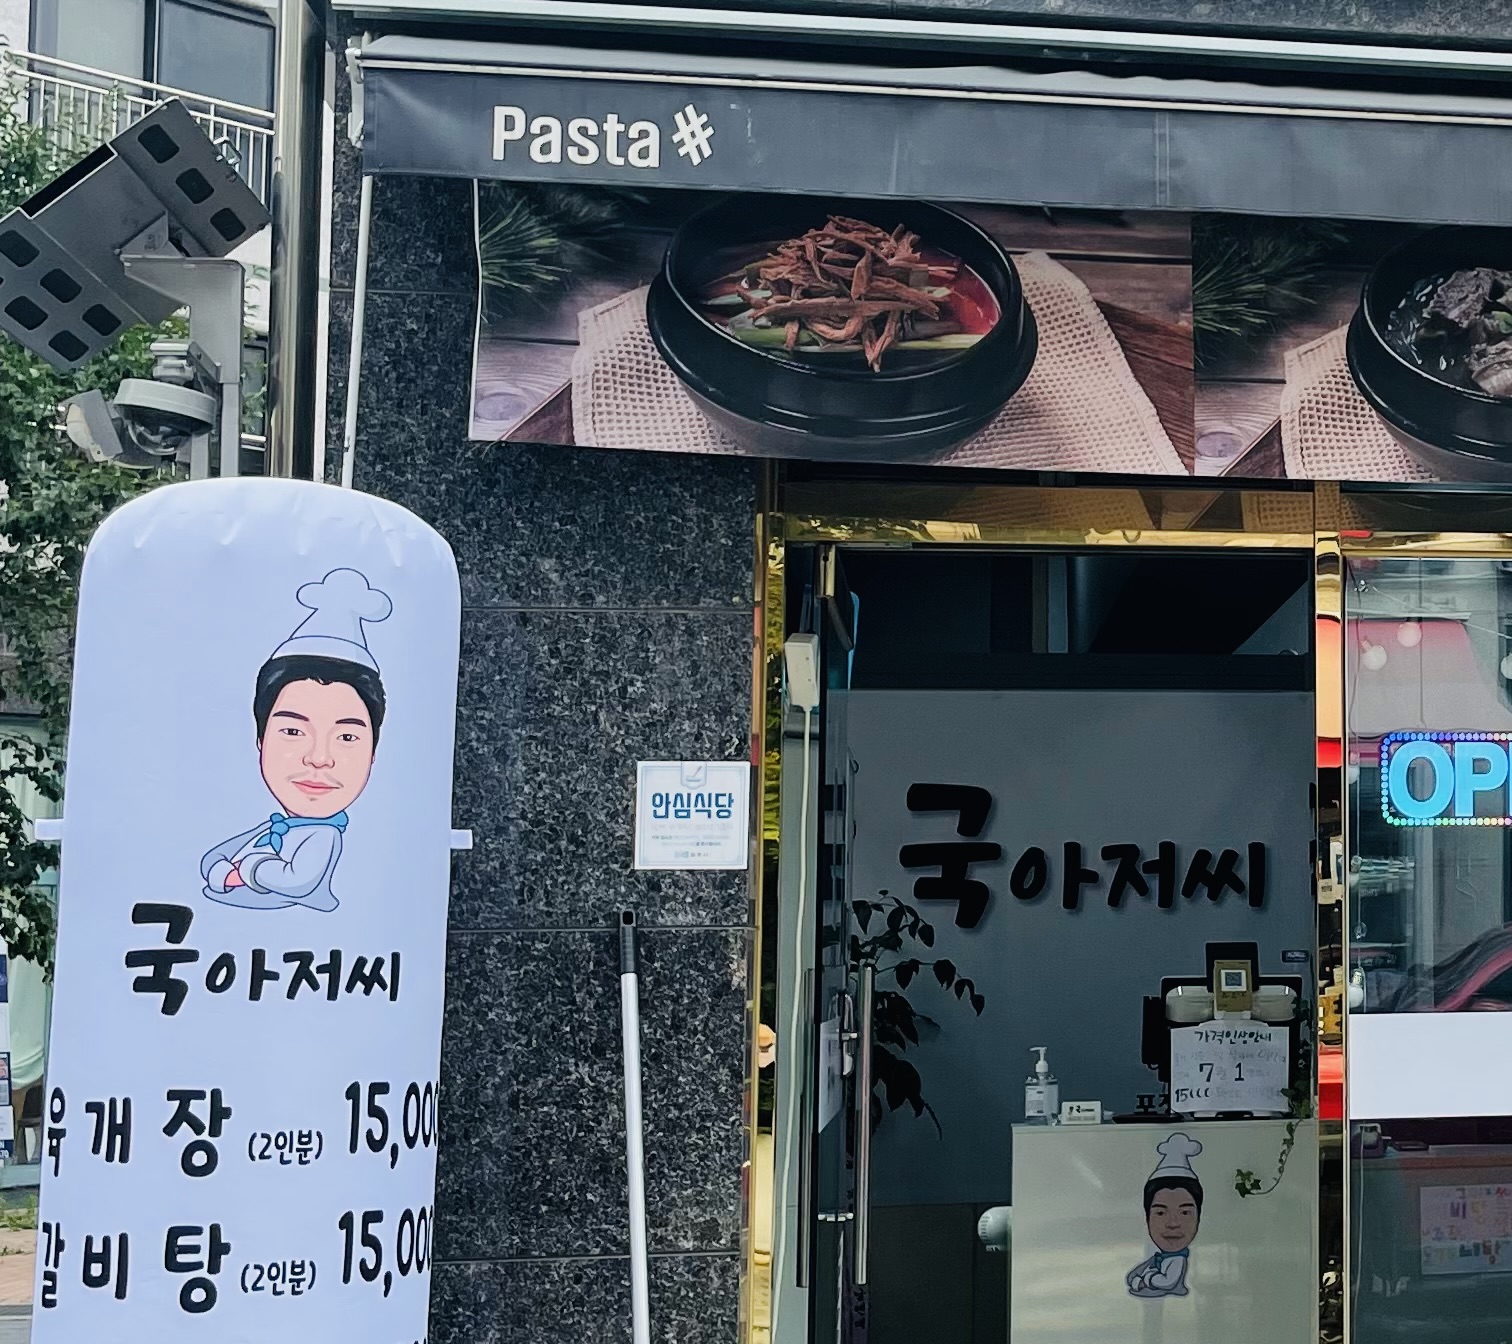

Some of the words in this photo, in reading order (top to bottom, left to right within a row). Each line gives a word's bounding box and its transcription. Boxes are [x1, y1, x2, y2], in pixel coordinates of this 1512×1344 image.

[651, 792, 734, 819] 안심식당
[899, 783, 1266, 929] 국아저씨
[125, 903, 401, 1016] 국아저씨
[248, 1130, 323, 1165] (2인분)
[240, 1259, 316, 1296] (2인분)
